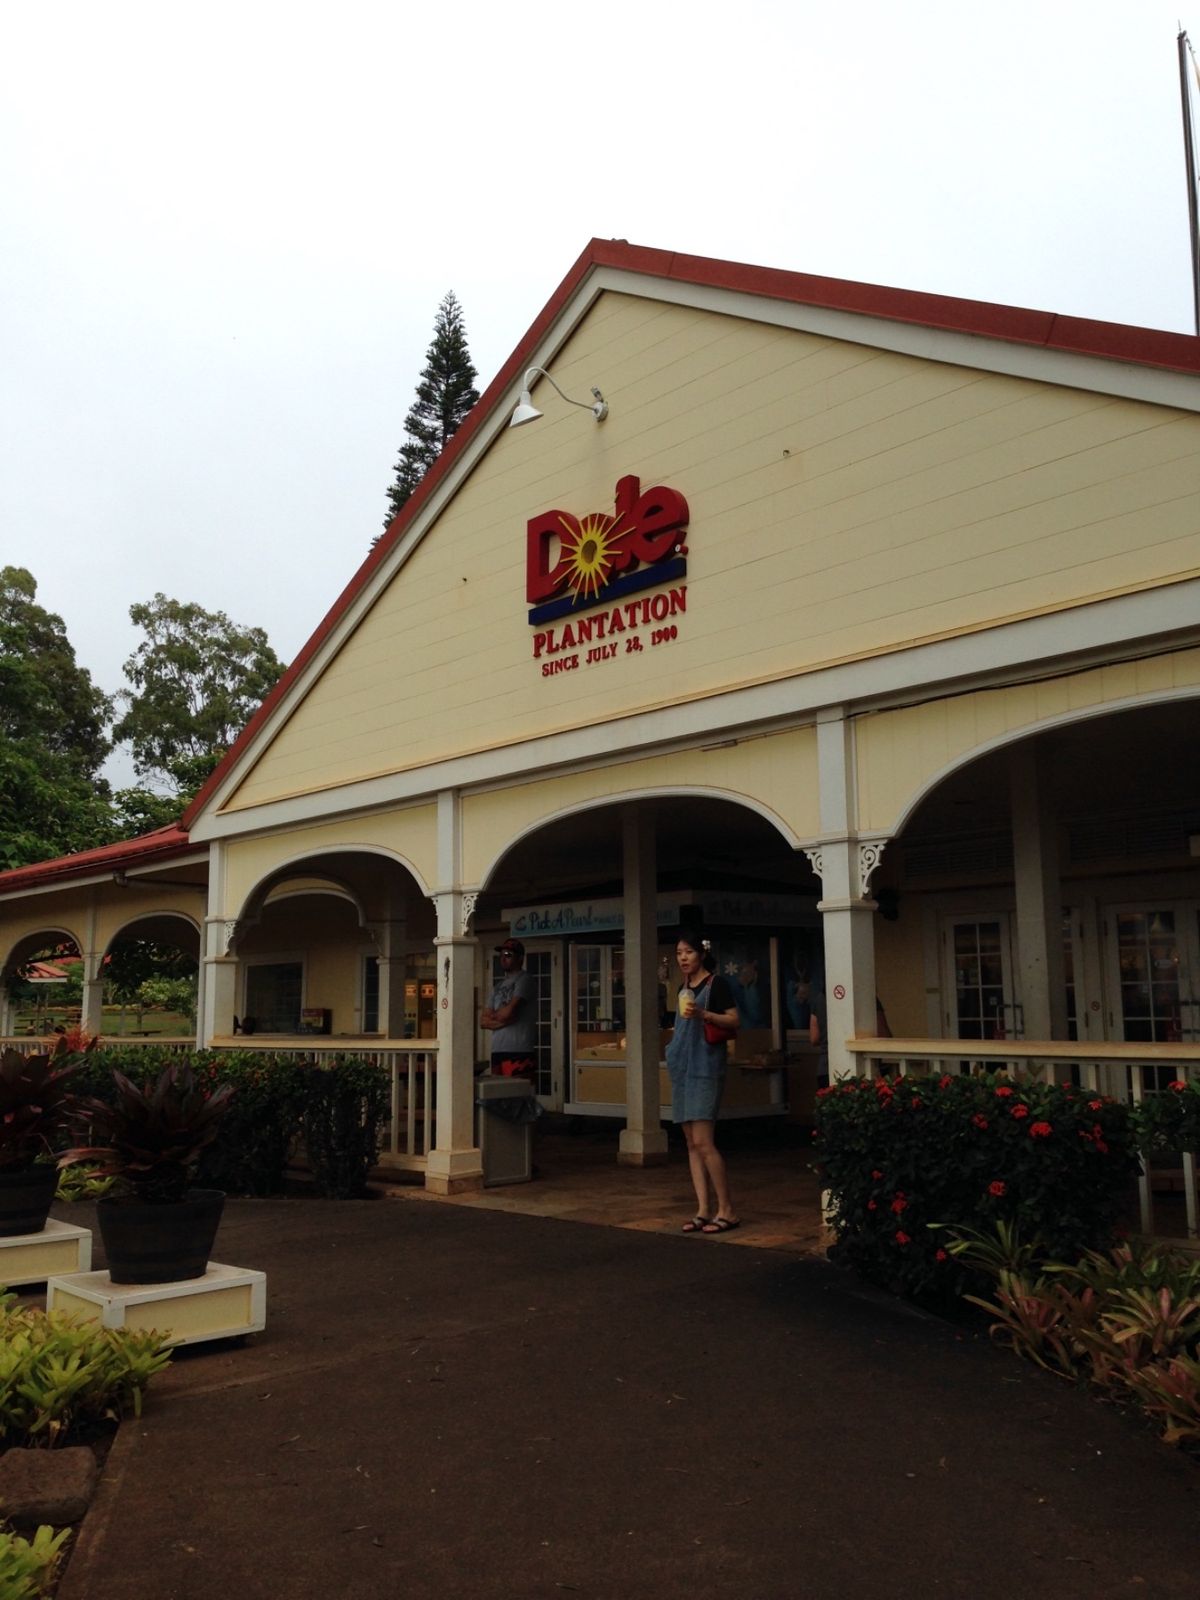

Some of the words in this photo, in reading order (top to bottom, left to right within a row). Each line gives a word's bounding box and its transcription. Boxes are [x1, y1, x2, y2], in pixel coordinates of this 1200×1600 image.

[527, 475, 689, 603] Dole
[533, 586, 687, 657] PLANTATION
[542, 655, 579, 677] SINCE
[586, 642, 618, 663] JULY
[626, 636, 642, 652] 28,
[651, 625, 677, 645] 1900
